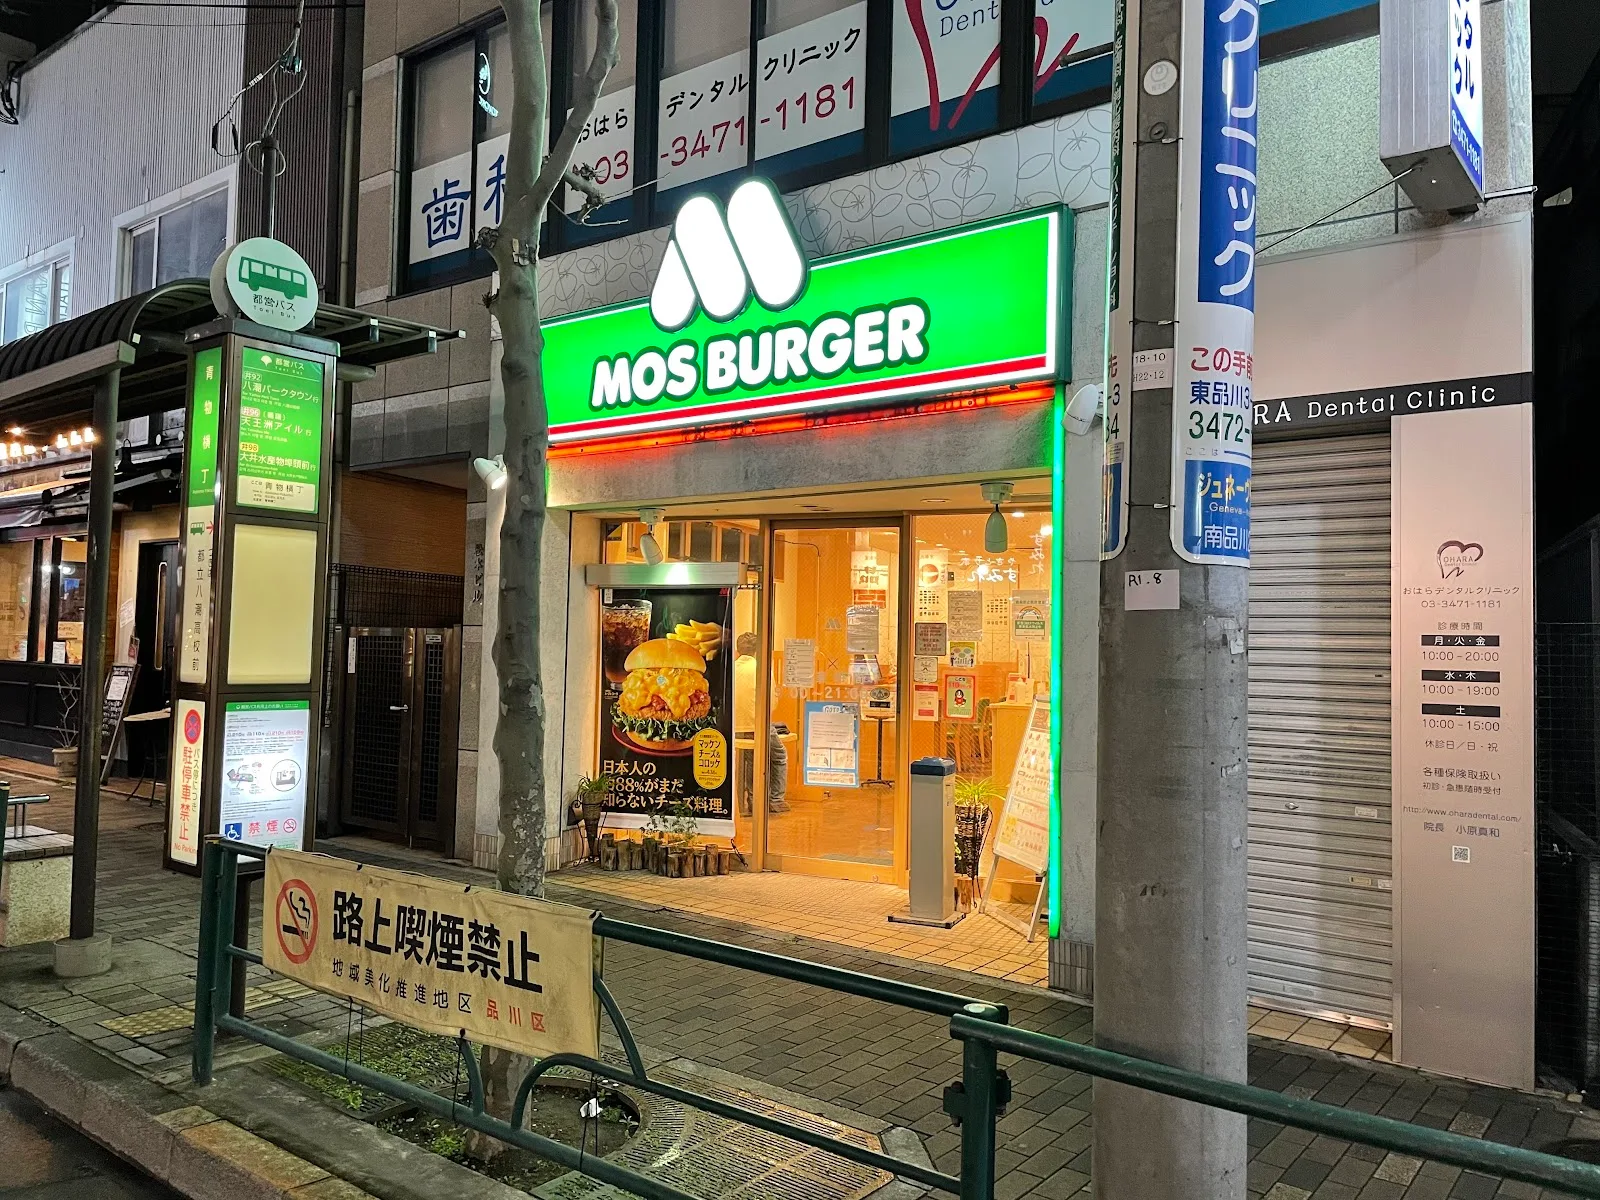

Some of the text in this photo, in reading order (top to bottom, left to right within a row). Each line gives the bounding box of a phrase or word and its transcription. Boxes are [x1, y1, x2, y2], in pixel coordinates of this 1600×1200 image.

[666, 73, 748, 117] デンタル
[764, 28, 861, 81] クリニック
[253, 294, 295, 312] 都営バス
[592, 304, 925, 408] MOS BURGER
[275, 358, 304, 371] 都営バス
[1308, 394, 1394, 419] Dental
[1407, 385, 1496, 410] Clinic
[201, 364, 214, 484] 青物横丁
[242, 443, 258, 451] 井98
[1186, 447, 1218, 456] ここは
[265, 481, 304, 494] 青物横丁
[1403, 586, 1520, 595] おはらデンタルクリニック
[1421, 600, 1501, 608] 03-3471-1181
[1437, 621, 1483, 631] 診療時間
[1455, 705, 1466, 715] 土
[699, 739, 721, 749] マッケン
[603, 760, 657, 776] 日本人の
[699, 759, 721, 768] コロッケ
[1423, 767, 1501, 781] 各種保険取扱い
[179, 746, 193, 841] 駐停車禁止
[1403, 806, 1522, 823] http://www.oharadental.com/
[1424, 822, 1444, 833] 院長
[333, 890, 543, 993] 路上喫煙禁止
[332, 957, 547, 1033] 地域美化推進地区 品川区
